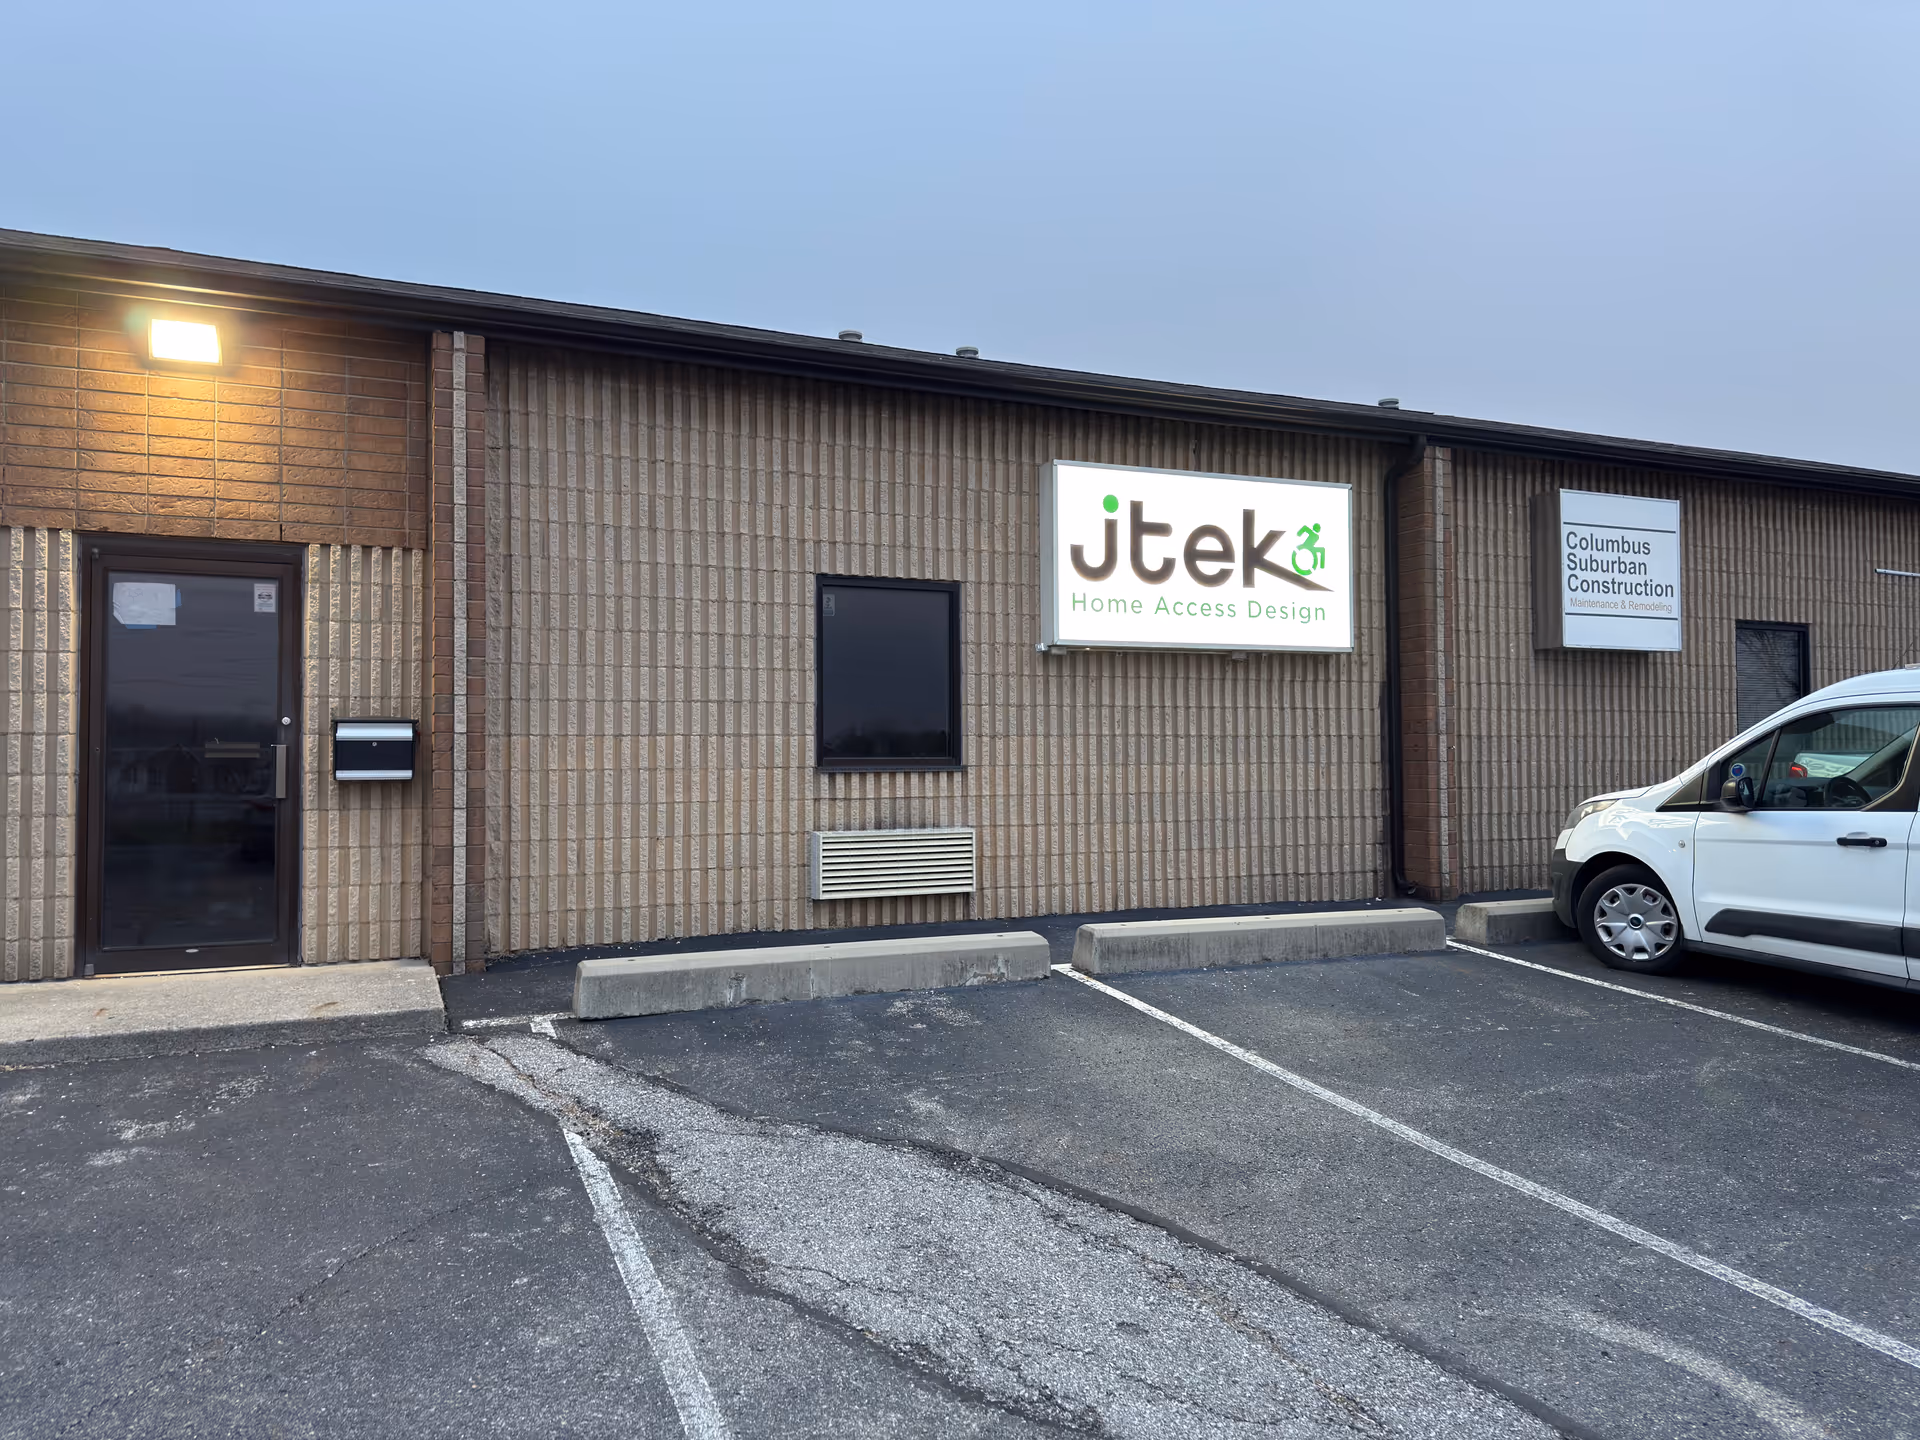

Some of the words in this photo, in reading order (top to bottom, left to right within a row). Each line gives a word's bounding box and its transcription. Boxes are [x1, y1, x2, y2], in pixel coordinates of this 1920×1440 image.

[1070, 494, 1335, 592] jtek
[1566, 531, 1651, 555] Columbus
[1567, 552, 1647, 575] Suburban
[1567, 573, 1674, 597] Construction
[1072, 592, 1143, 614] Home
[1154, 596, 1236, 618] Access
[1248, 600, 1326, 624] Design
[1570, 598, 1619, 609] Maintenance
[1620, 600, 1627, 610] &
[1628, 600, 1672, 613] Remodeling
